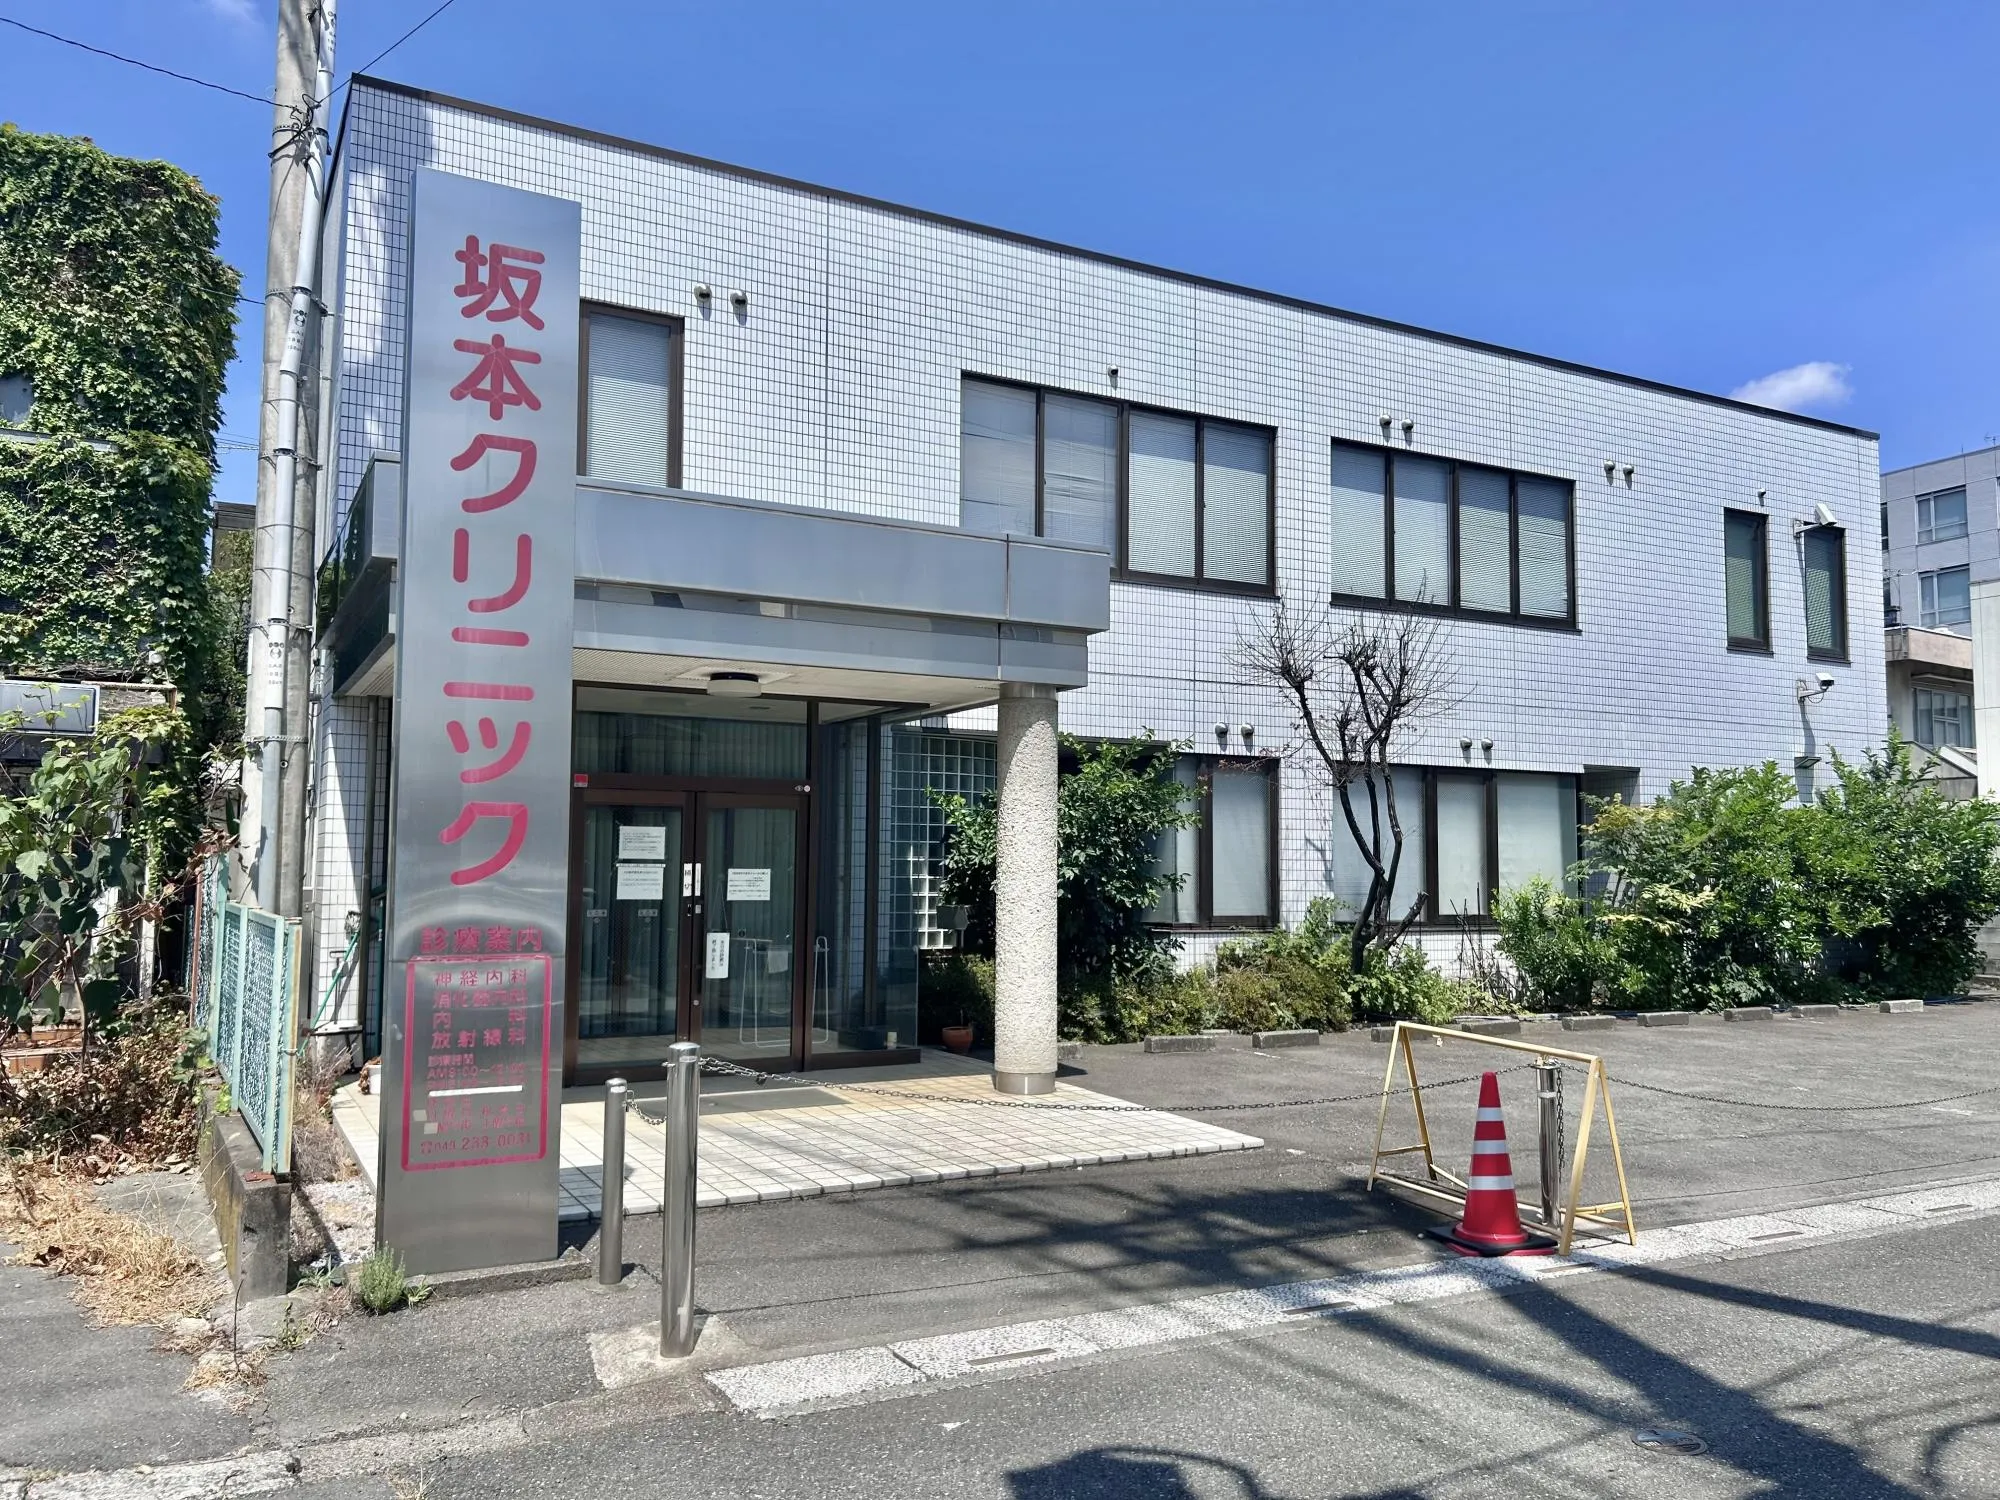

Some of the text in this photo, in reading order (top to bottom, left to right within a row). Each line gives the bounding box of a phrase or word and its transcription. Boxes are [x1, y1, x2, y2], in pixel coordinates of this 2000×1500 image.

[438, 234, 546, 886] 坂本クリニック
[434, 968, 527, 987] 神経内科
